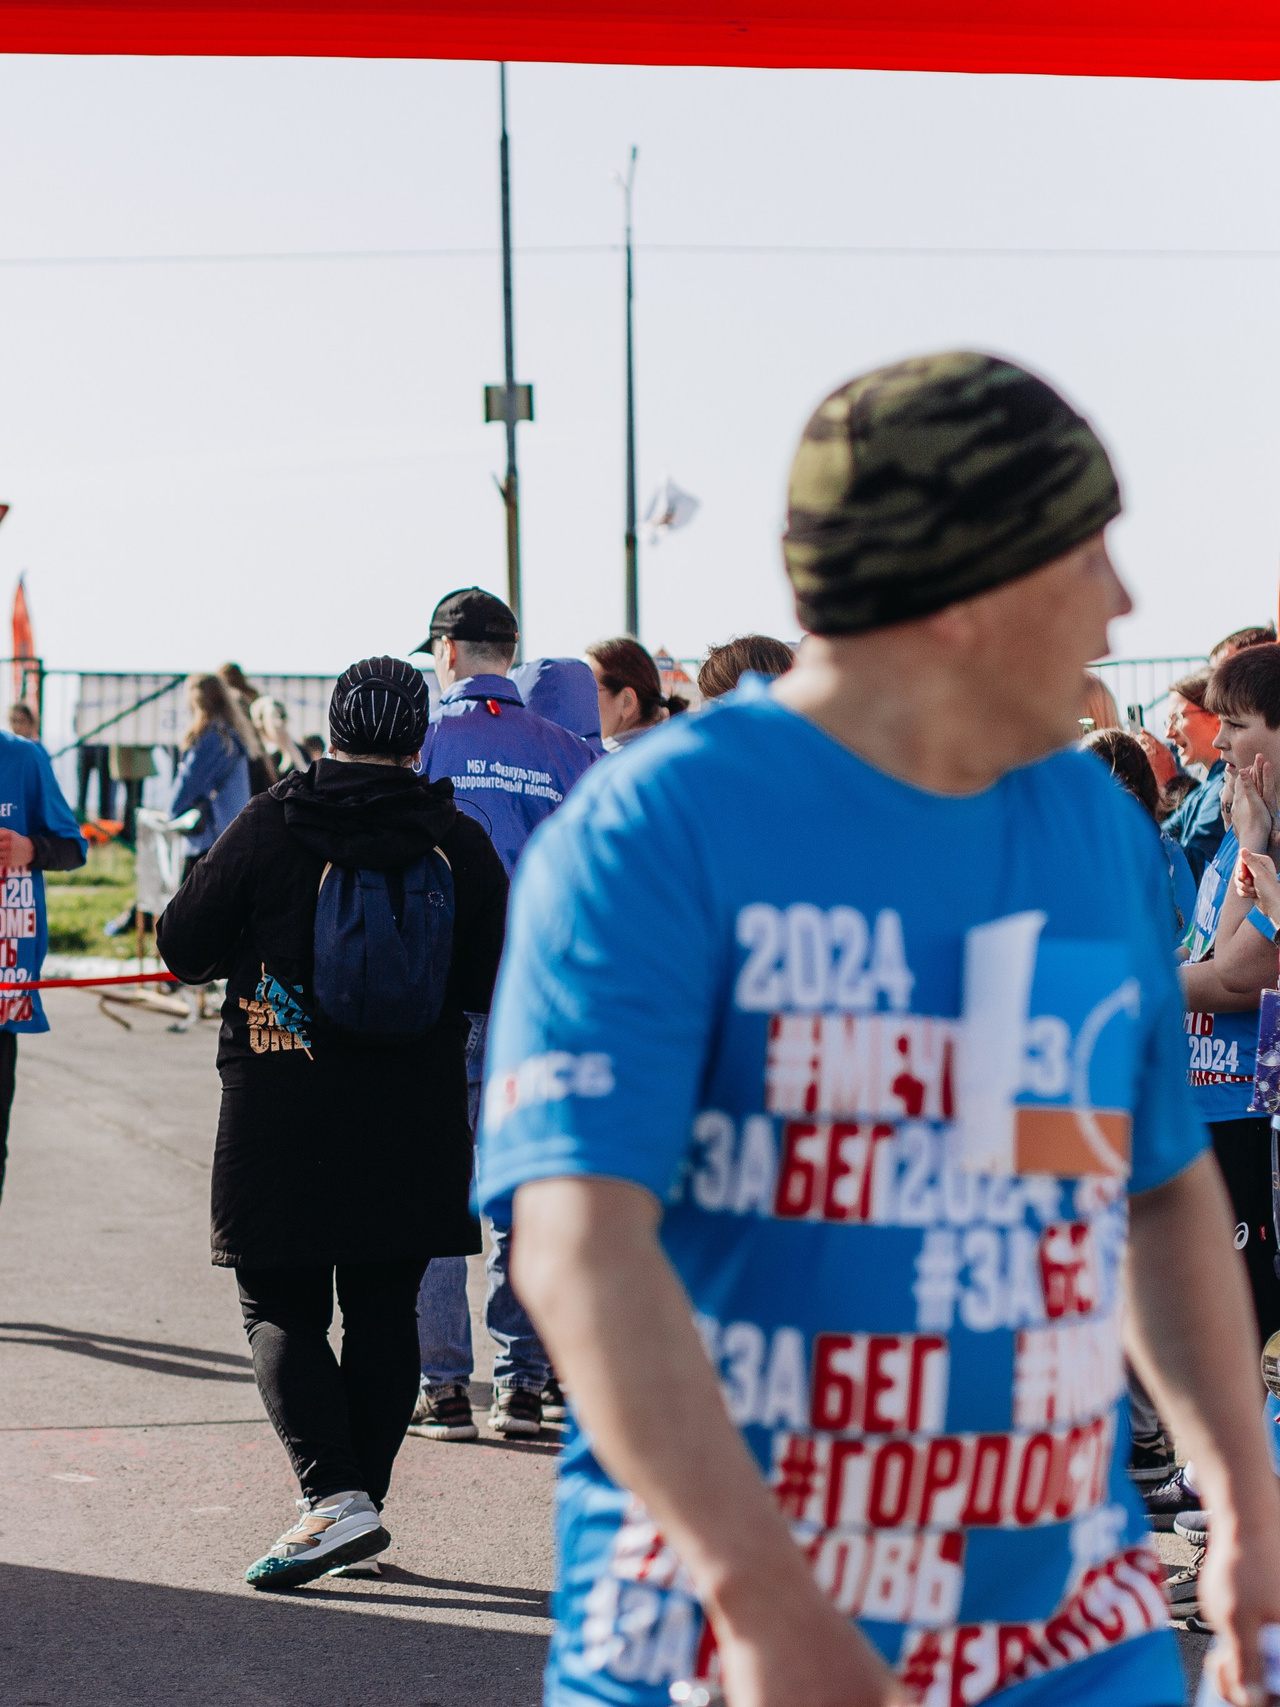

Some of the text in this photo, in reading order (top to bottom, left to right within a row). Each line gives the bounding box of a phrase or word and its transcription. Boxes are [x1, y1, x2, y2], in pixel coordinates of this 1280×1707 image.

[467, 760, 487, 773] МБУ
[736, 902, 915, 1012] 2024
[1188, 1036, 1239, 1073] 2024
